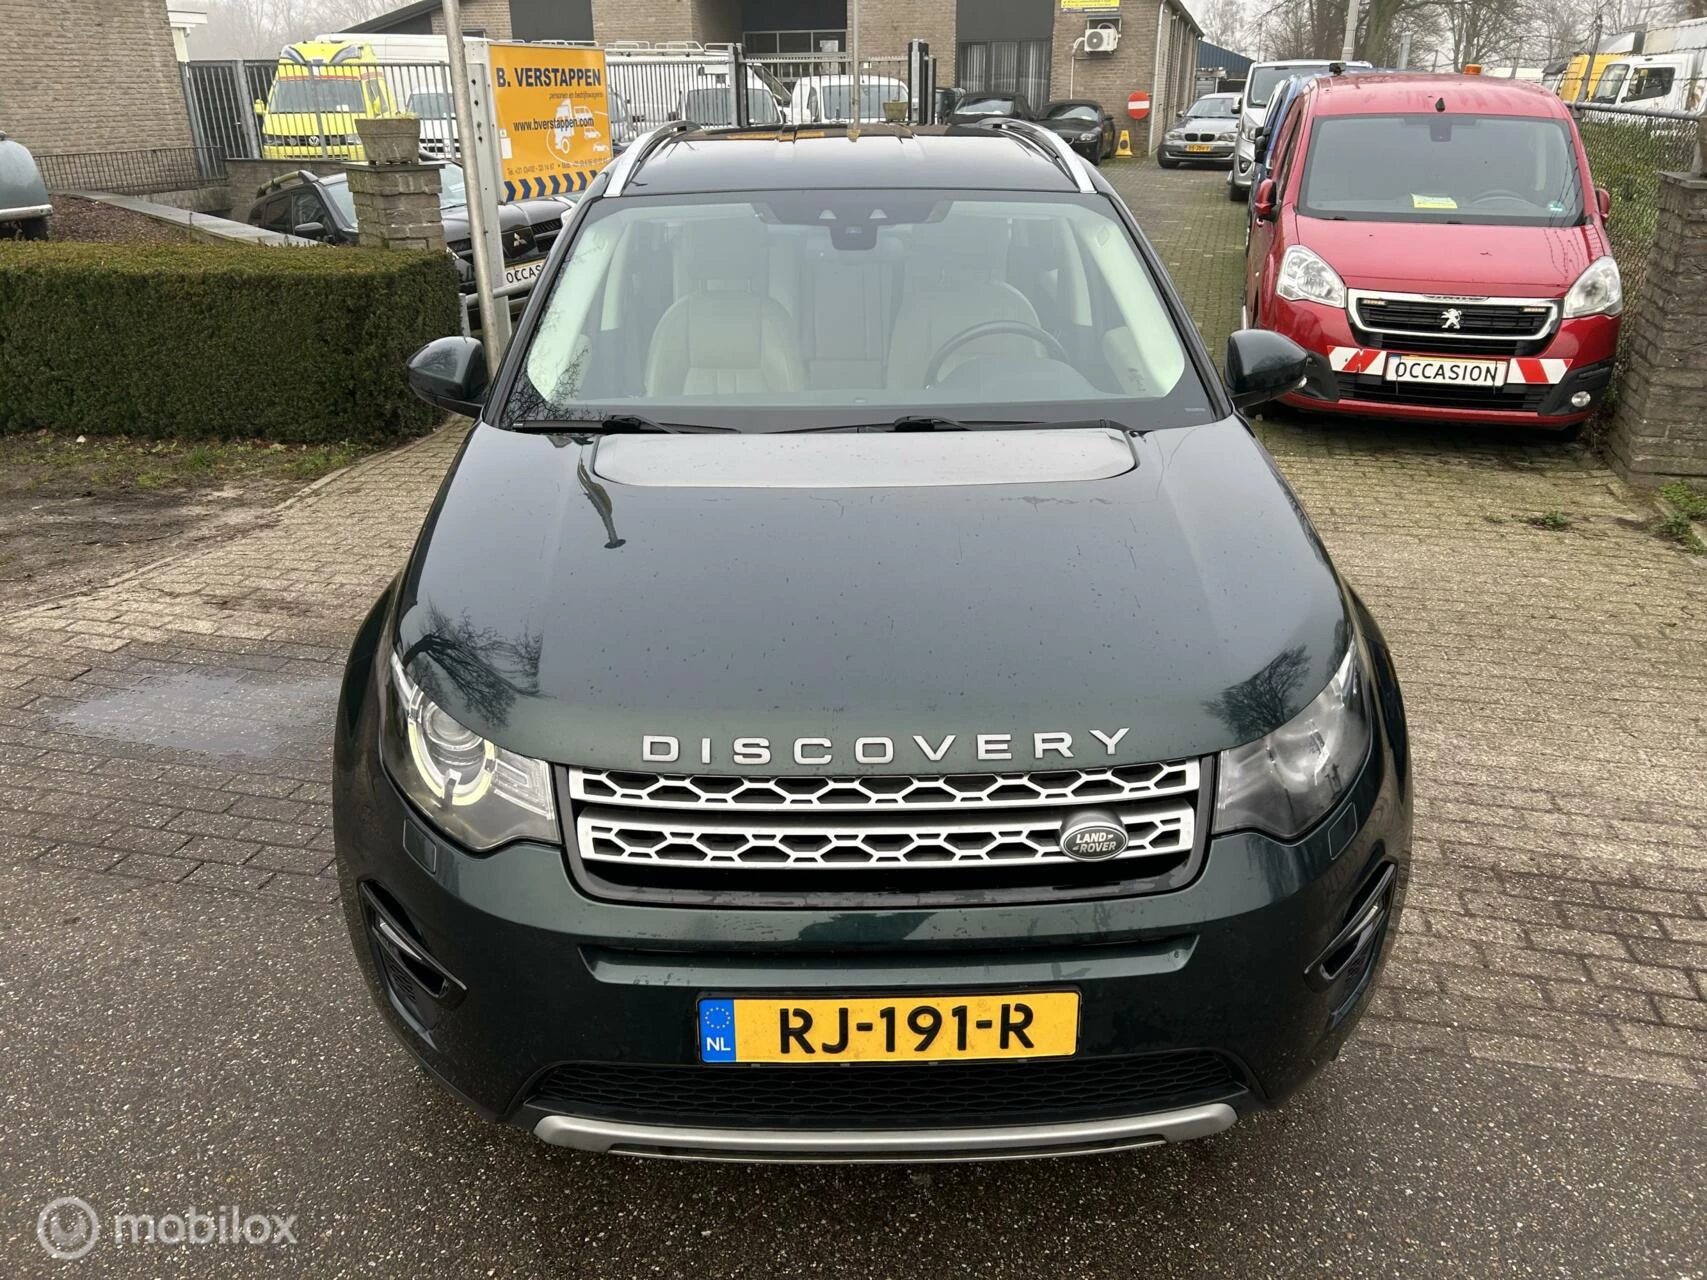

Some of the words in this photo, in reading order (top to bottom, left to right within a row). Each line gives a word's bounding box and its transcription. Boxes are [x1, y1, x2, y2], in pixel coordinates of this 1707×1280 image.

[496, 67, 511, 87] B.
[514, 67, 602, 87] VERSTAPPEN
[513, 117, 595, 132] www.bverstappen.com
[1395, 361, 1498, 382] OCCASION
[642, 728, 1130, 764] DISCOVERY
[1075, 832, 1107, 844] LAND
[1079, 841, 1117, 853] ROVER
[706, 1037, 731, 1052] NL
[779, 1003, 1036, 1055] RJ-191-R
